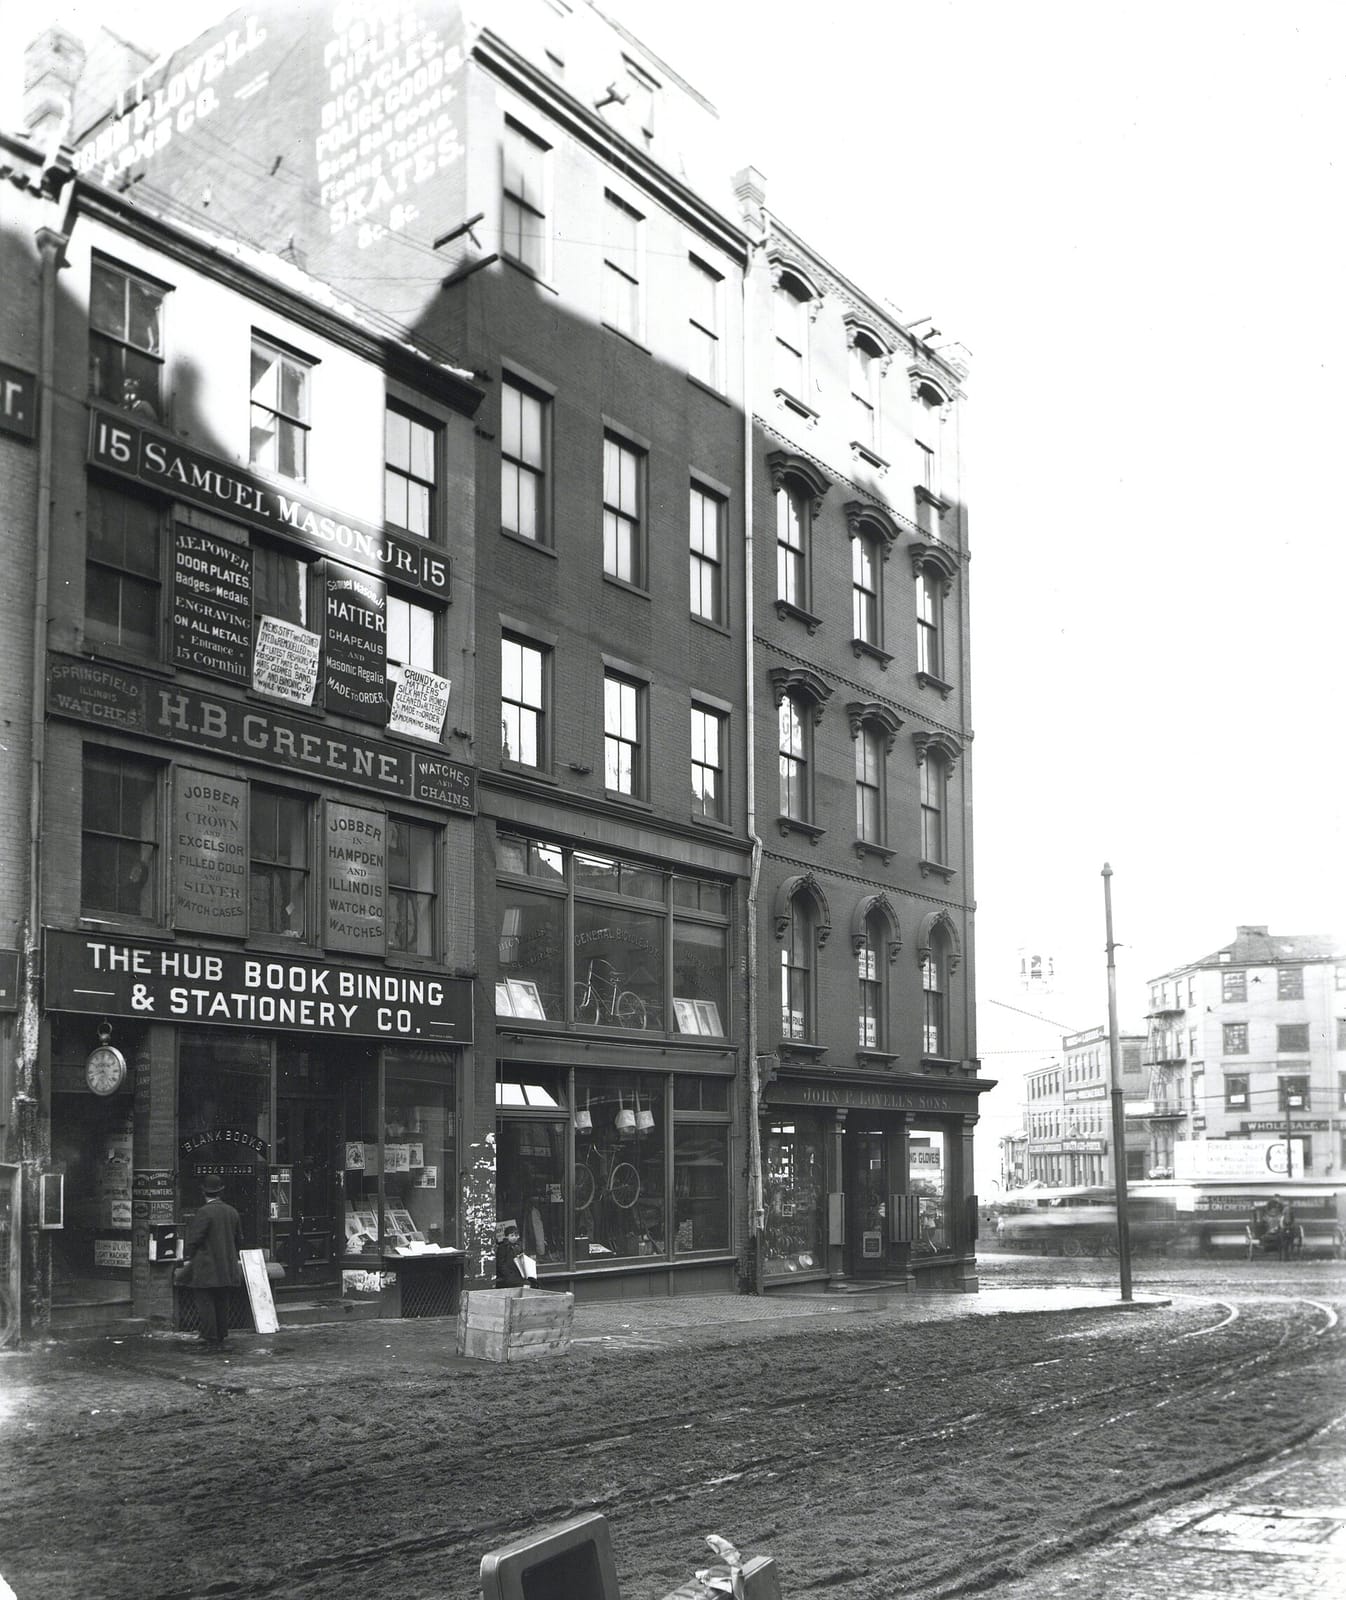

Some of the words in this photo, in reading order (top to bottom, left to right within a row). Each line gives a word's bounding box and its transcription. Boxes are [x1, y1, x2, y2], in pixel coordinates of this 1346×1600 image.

[153, 15, 268, 120] LOVELL
[316, 96, 385, 161] POLICE
[360, 119, 393, 157] Ball
[321, 153, 382, 206] Fishing
[99, 423, 132, 463] 15
[145, 442, 271, 518] SAMUEL
[375, 540, 418, 576] JR.
[177, 552, 208, 575] DOOR
[423, 556, 446, 587] 15
[176, 571, 210, 594] Badges
[176, 595, 251, 630] ENGRAVING
[175, 614, 188, 628] ON
[191, 620, 210, 635] ALL
[177, 646, 190, 661] 15
[191, 635, 234, 657] Entrance
[328, 628, 384, 656] CHAPEAUS
[348, 651, 365, 662] AND
[52, 664, 140, 698] SPRINGFIELD
[326, 656, 357, 676] Masonic
[357, 665, 384, 685] Regalia
[79, 686, 118, 703] ILLINOIS
[327, 676, 350, 699] MADE
[398, 684, 414, 696] SILK
[414, 690, 428, 702] HATS
[406, 679, 440, 697] HATTERS
[395, 692, 422, 709] CLEANED
[418, 762, 471, 788] WATCHES
[184, 786, 240, 809] JOBBER
[185, 811, 240, 831] CROWN
[330, 818, 382, 842] JOBBER
[179, 834, 245, 857] EXCELSIOR
[328, 845, 384, 868] HAMPDEN
[179, 855, 216, 872] FILLED
[217, 861, 245, 877] GOLD
[346, 866, 368, 878] AND
[183, 880, 241, 900] SILVER
[329, 876, 383, 898] ILLINOIS
[177, 896, 210, 917] WATCH
[328, 898, 367, 917] WATCH
[574, 927, 615, 947] GENERAL
[87, 942, 152, 976] THE
[161, 951, 223, 982] HUB
[244, 960, 330, 996] BOOK
[338, 971, 444, 1007] BINDING
[131, 983, 155, 1012] &
[169, 987, 359, 1029] STATIONERY
[377, 1007, 422, 1035] CO.
[803, 1087, 841, 1105] JOHN
[919, 1152, 940, 1164] GLOVES
